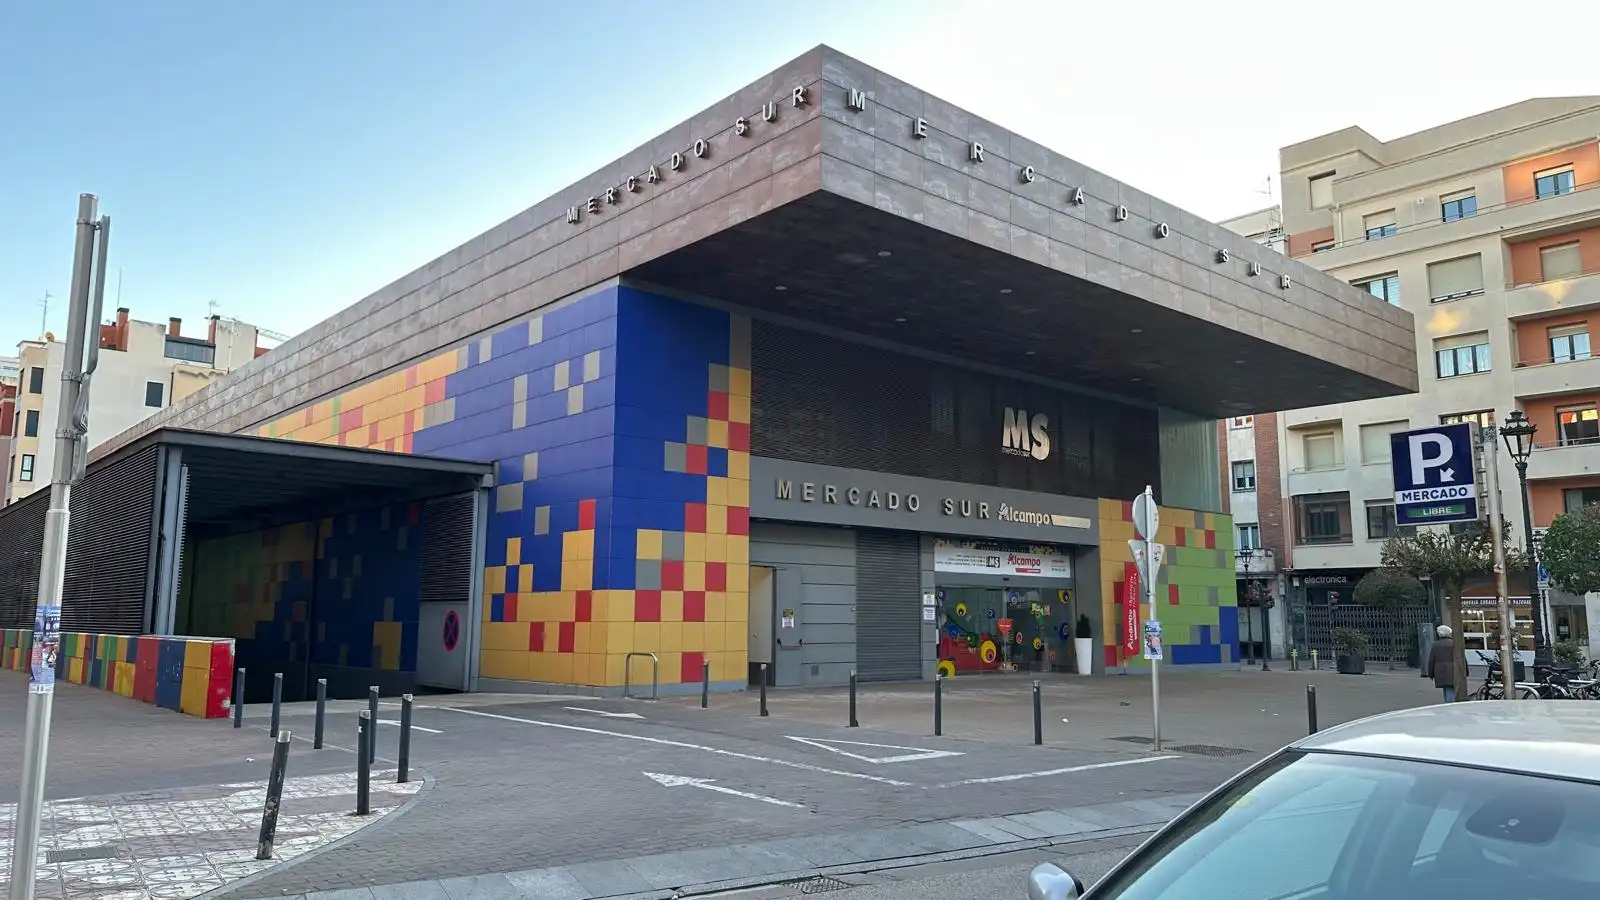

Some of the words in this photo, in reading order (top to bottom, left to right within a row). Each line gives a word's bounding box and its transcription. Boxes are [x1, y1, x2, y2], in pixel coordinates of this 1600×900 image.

[567, 139, 709, 224] MERCADO
[735, 85, 808, 136] SUR
[848, 88, 1169, 239] MERCADO
[1219, 248, 1291, 289] SUR
[1002, 406, 1050, 460] MS
[1408, 433, 1453, 485] P
[776, 477, 920, 512] MERCADO
[943, 497, 989, 519] SUR
[998, 502, 1050, 527] Alcampo
[1402, 486, 1468, 502] MERCADO
[1422, 506, 1452, 516] LIBRE
[1007, 552, 1041, 567] Alcampo
